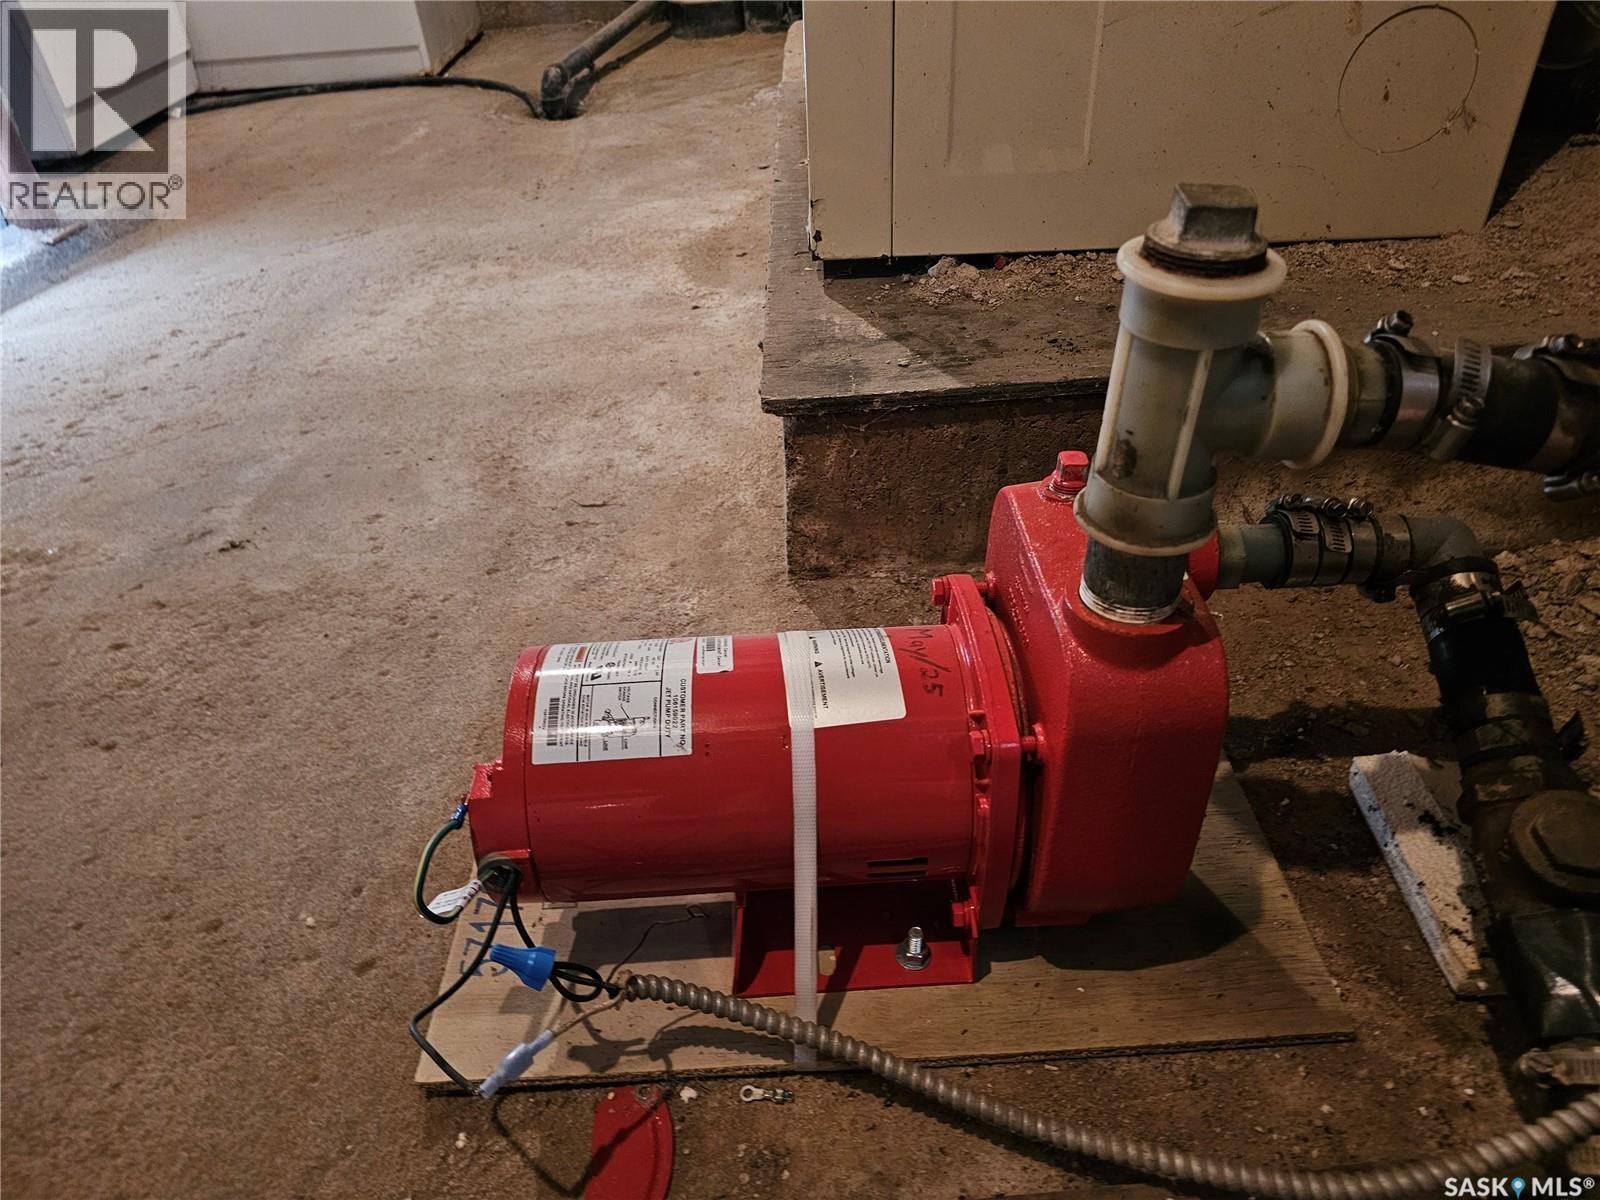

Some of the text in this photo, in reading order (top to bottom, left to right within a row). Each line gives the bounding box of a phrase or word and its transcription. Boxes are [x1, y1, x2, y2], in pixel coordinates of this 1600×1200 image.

[897, 629, 952, 697] May/25
[679, 678, 687, 713] CUSTOMER
[664, 719, 672, 738] DUTY
[679, 714, 687, 732] PART
